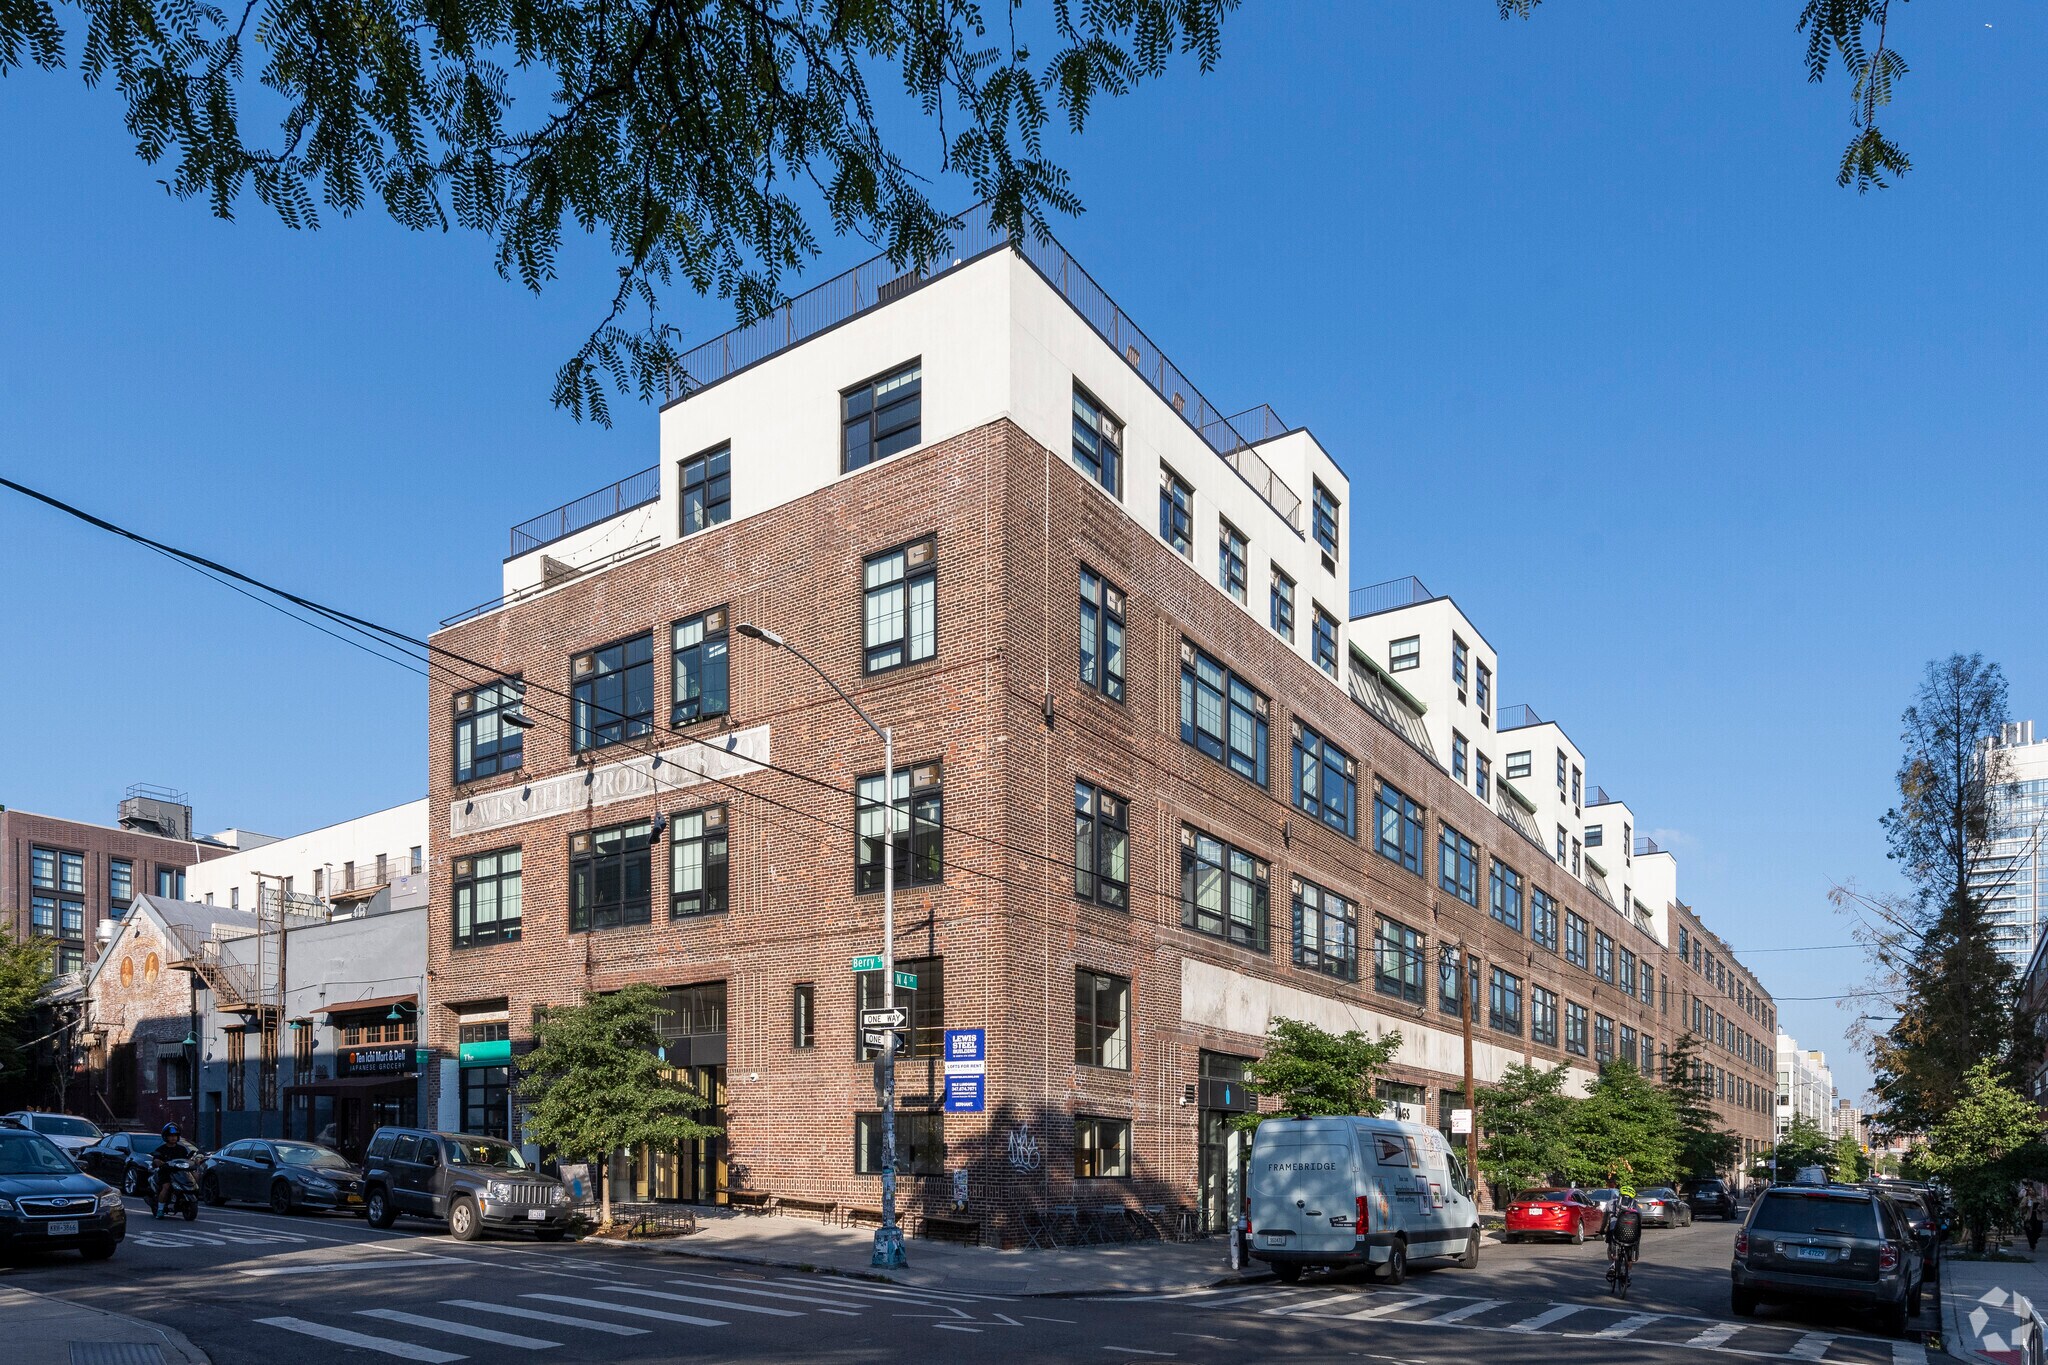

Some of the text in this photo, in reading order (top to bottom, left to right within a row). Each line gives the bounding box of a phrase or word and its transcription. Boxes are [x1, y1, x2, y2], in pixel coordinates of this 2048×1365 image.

[455, 794, 514, 831] LEWIS
[590, 747, 709, 803] PRODCTS
[853, 958, 875, 969] Berry
[896, 973, 902, 985] N
[903, 975, 908, 986] 4
[867, 1014, 901, 1024] ONE WAY
[868, 1034, 882, 1044] ONE
[952, 1034, 977, 1043] LEWIS
[952, 1041, 977, 1049] STEEL
[356, 1052, 366, 1063] Ten
[366, 1051, 375, 1062] Ichi
[376, 1051, 389, 1062] Mart
[389, 1050, 394, 1061] &
[394, 1048, 406, 1060] Deli
[350, 1062, 406, 1071] JAPANESE GROCERY
[1268, 1162, 1336, 1172] FRAMEBRIDGE
